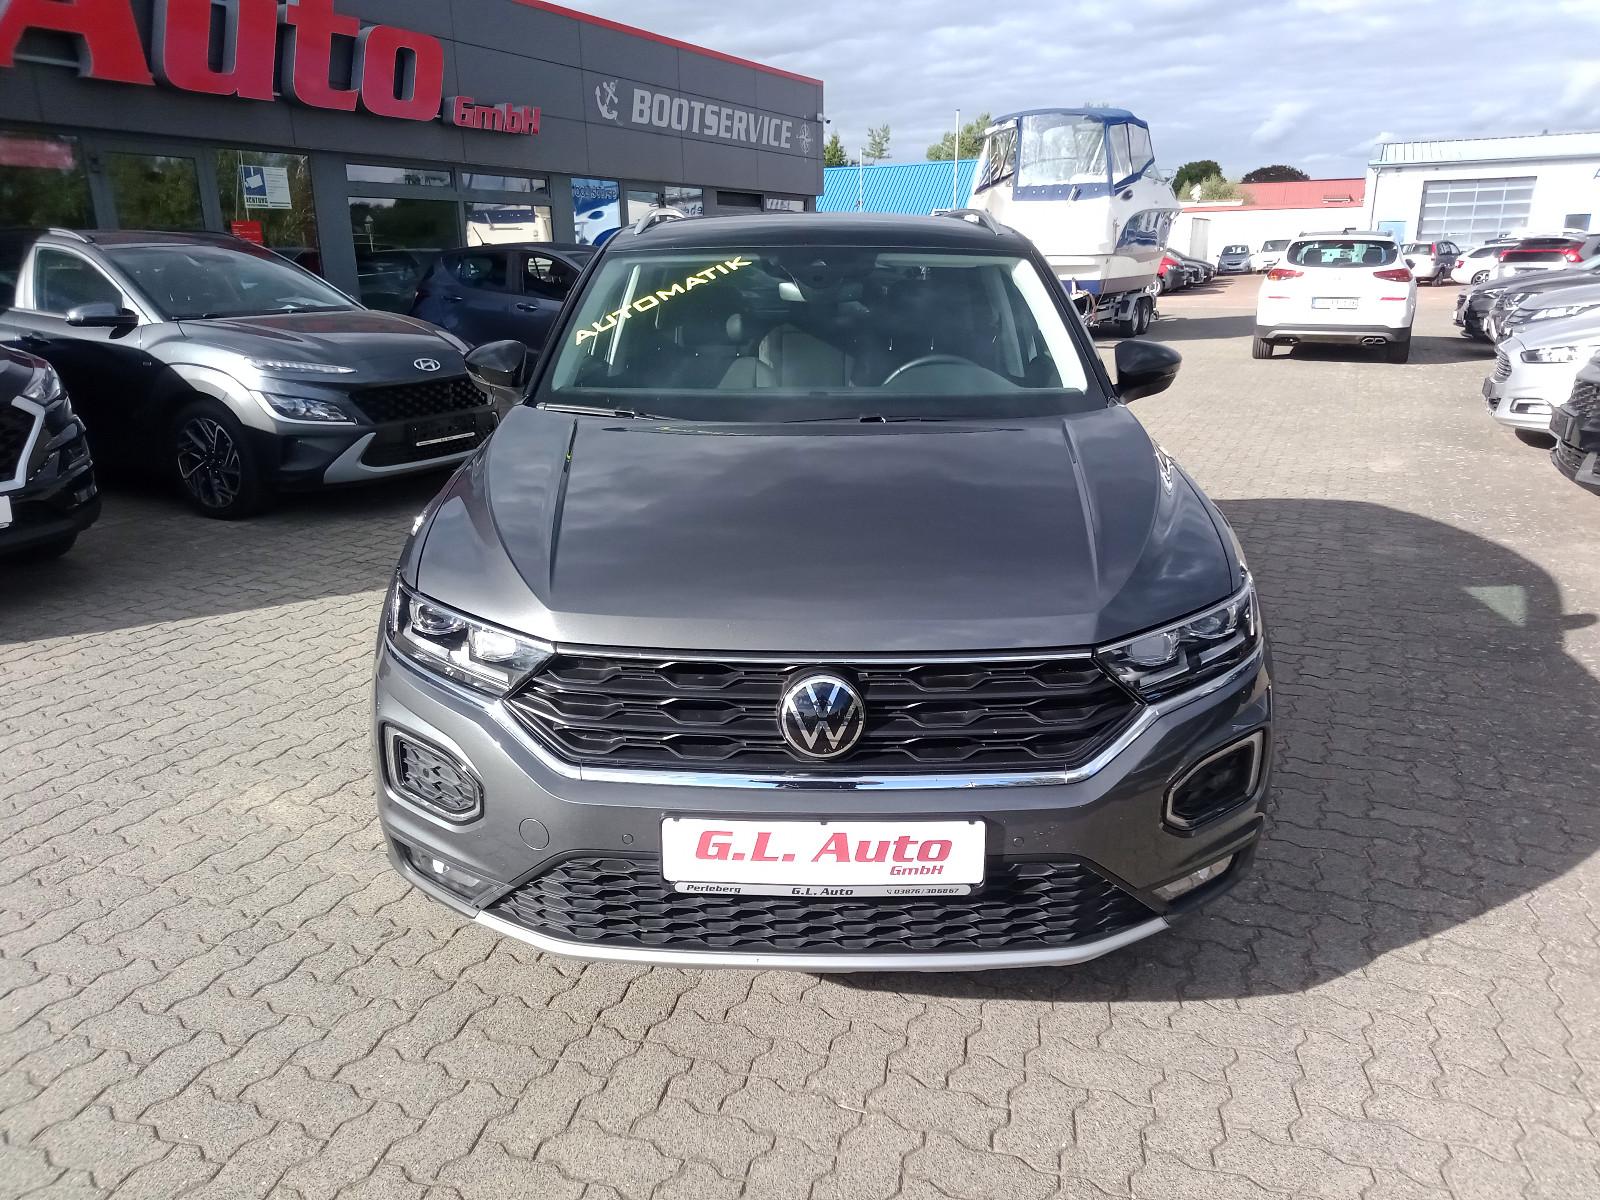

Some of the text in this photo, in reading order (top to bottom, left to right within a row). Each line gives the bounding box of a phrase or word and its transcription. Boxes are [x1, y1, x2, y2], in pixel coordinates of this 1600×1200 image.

[0, 0, 541, 135] Auto GmbH
[631, 88, 793, 149] BOOTSERVICE
[575, 256, 752, 346] AUTOMATIK
[695, 830, 953, 863] G.L. Auto
[686, 884, 741, 894] Perleberg
[791, 887, 817, 895] G.L.
[820, 887, 854, 896] Auto
[890, 865, 944, 876] GmbH
